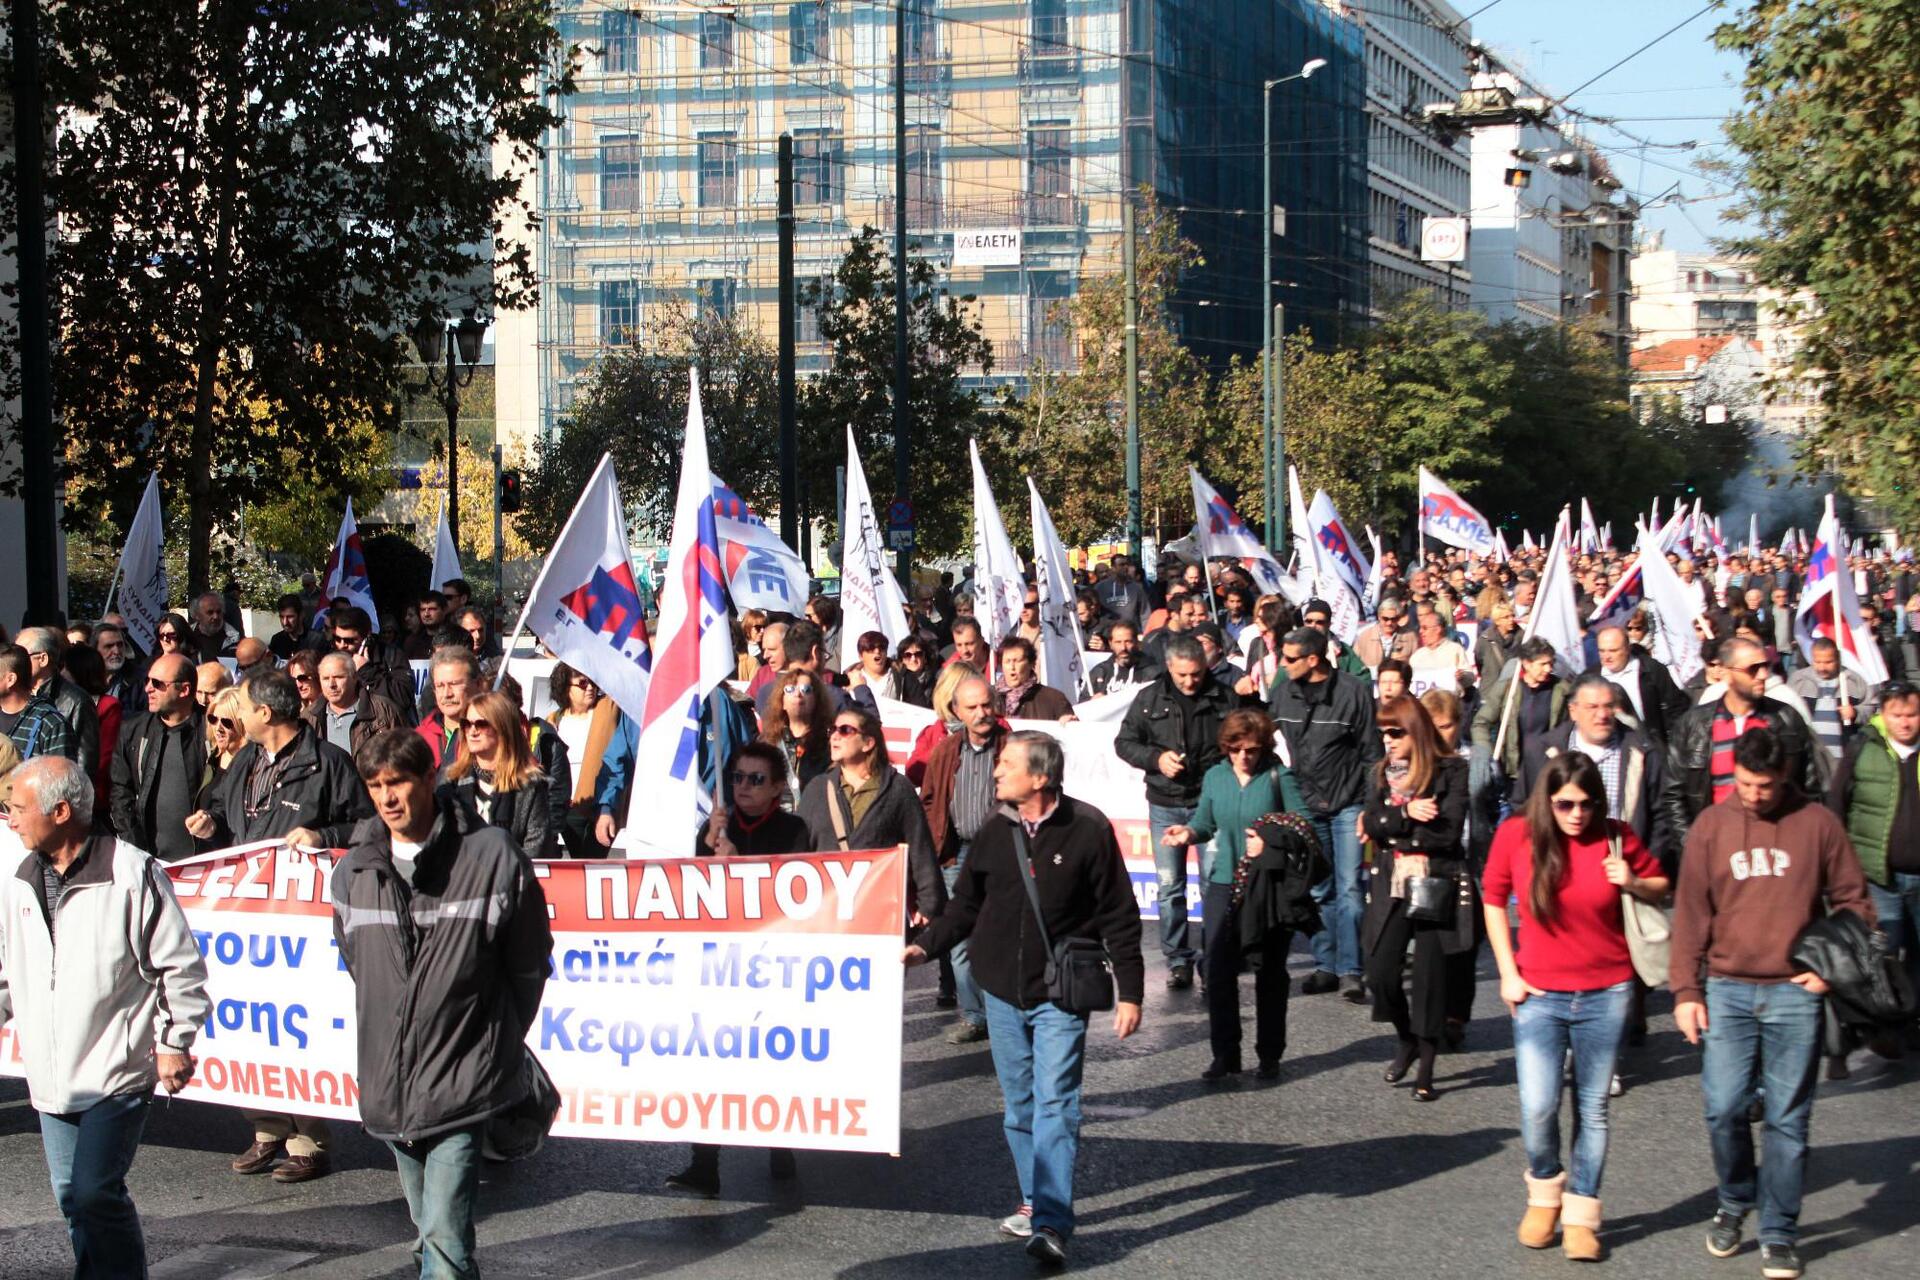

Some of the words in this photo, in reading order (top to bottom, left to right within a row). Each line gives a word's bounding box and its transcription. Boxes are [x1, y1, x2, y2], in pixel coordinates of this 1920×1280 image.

[583, 860, 874, 921] ΠΑΝΤΟΥ
[1729, 847, 1792, 880] GAP
[701, 939, 872, 1003] Μέτρα
[539, 1006, 831, 1067] Κεφαλαίου
[556, 1086, 869, 1137] ΠΕΤΡΟΥΠΟΛΗΣ
